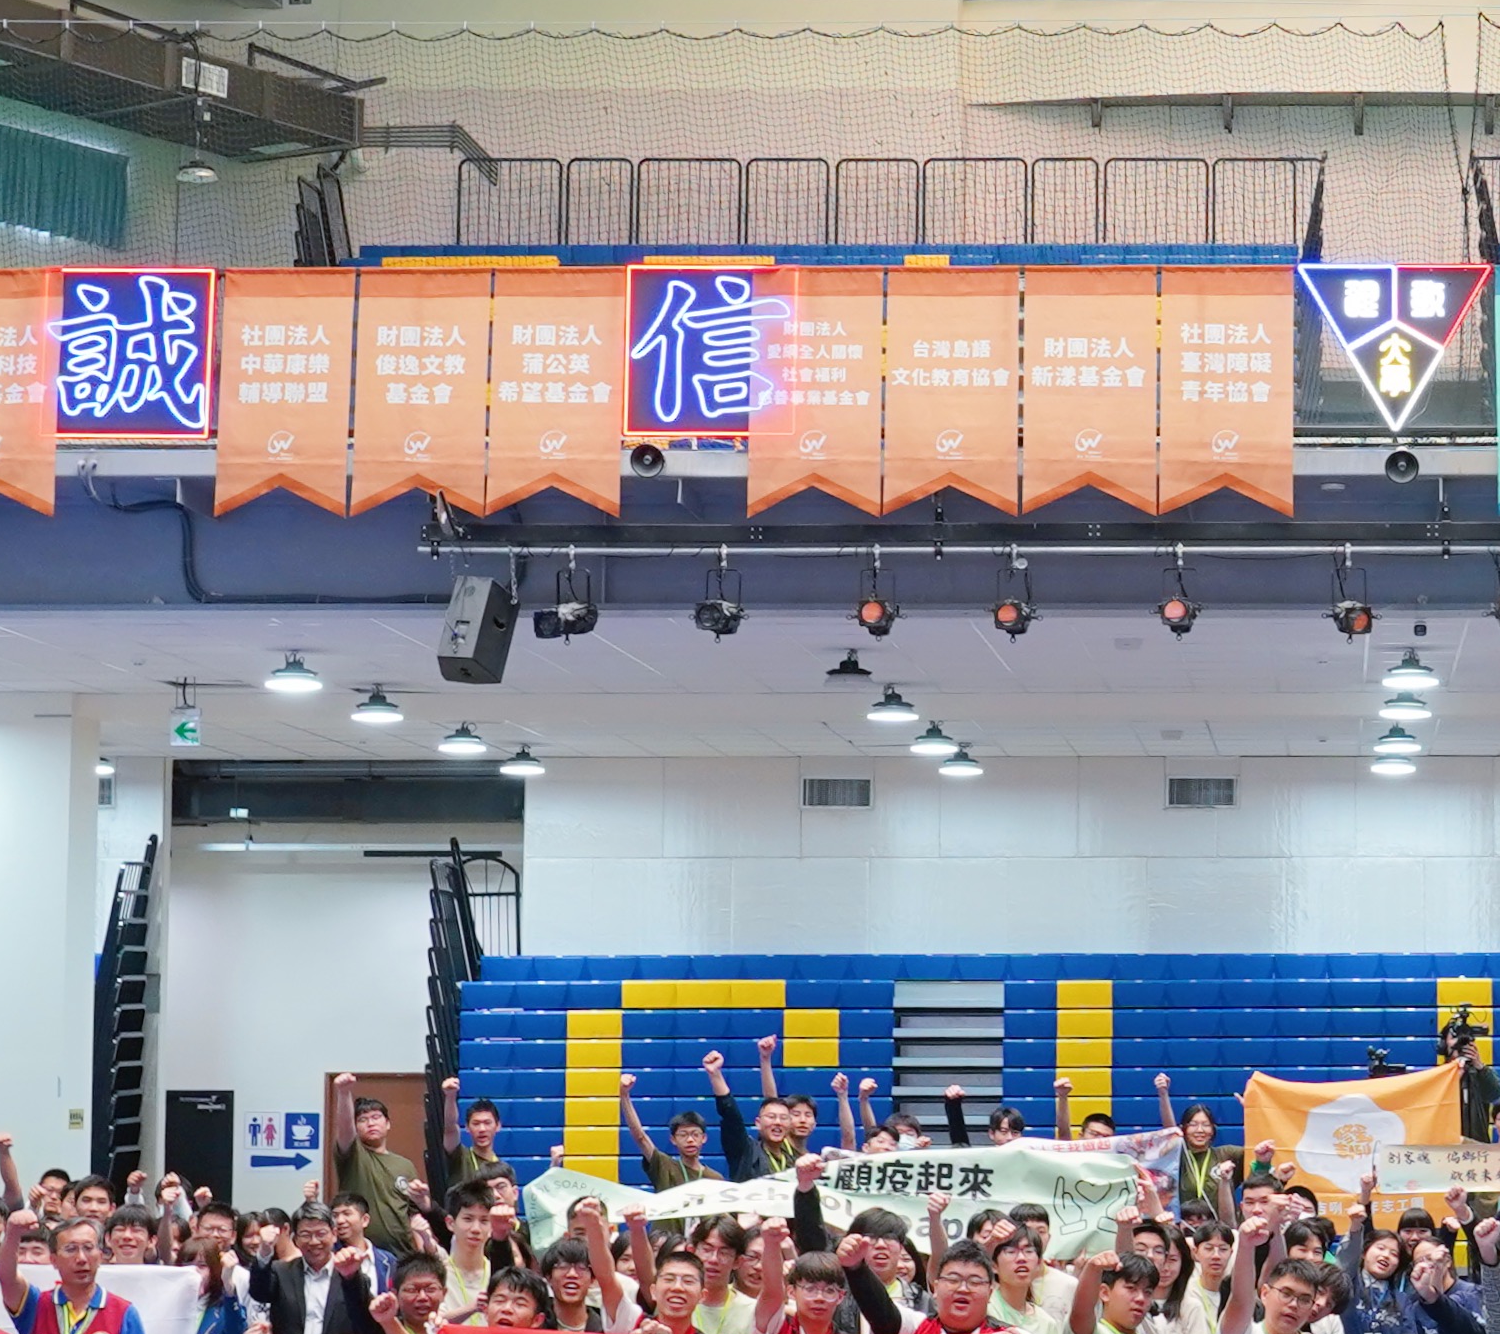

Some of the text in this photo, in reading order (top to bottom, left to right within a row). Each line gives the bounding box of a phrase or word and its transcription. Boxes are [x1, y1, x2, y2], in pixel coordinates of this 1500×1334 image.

[241, 324, 331, 347] 社團法人
[376, 325, 466, 347] 財團法人
[511, 324, 602, 347] 財團法人
[783, 321, 847, 337] 財團法人
[1180, 322, 1272, 345] 社團法人
[48, 274, 206, 431] 誠
[630, 274, 789, 423] 信
[912, 340, 991, 359] 台灣島語
[1043, 336, 1135, 359] 財團法人
[240, 353, 330, 376] 中華康樂
[375, 353, 466, 376] 俊逸文教
[521, 353, 591, 376] 蒲公英
[1179, 351, 1272, 375] 臺灣障礙
[782, 367, 847, 383] 社會福利
[891, 368, 1011, 387] 文化教育協會
[238, 382, 329, 404] 輔導聯盟
[385, 383, 453, 405] 基金會
[498, 382, 612, 405] 希望基金會
[1181, 380, 1272, 404] 青年協會
